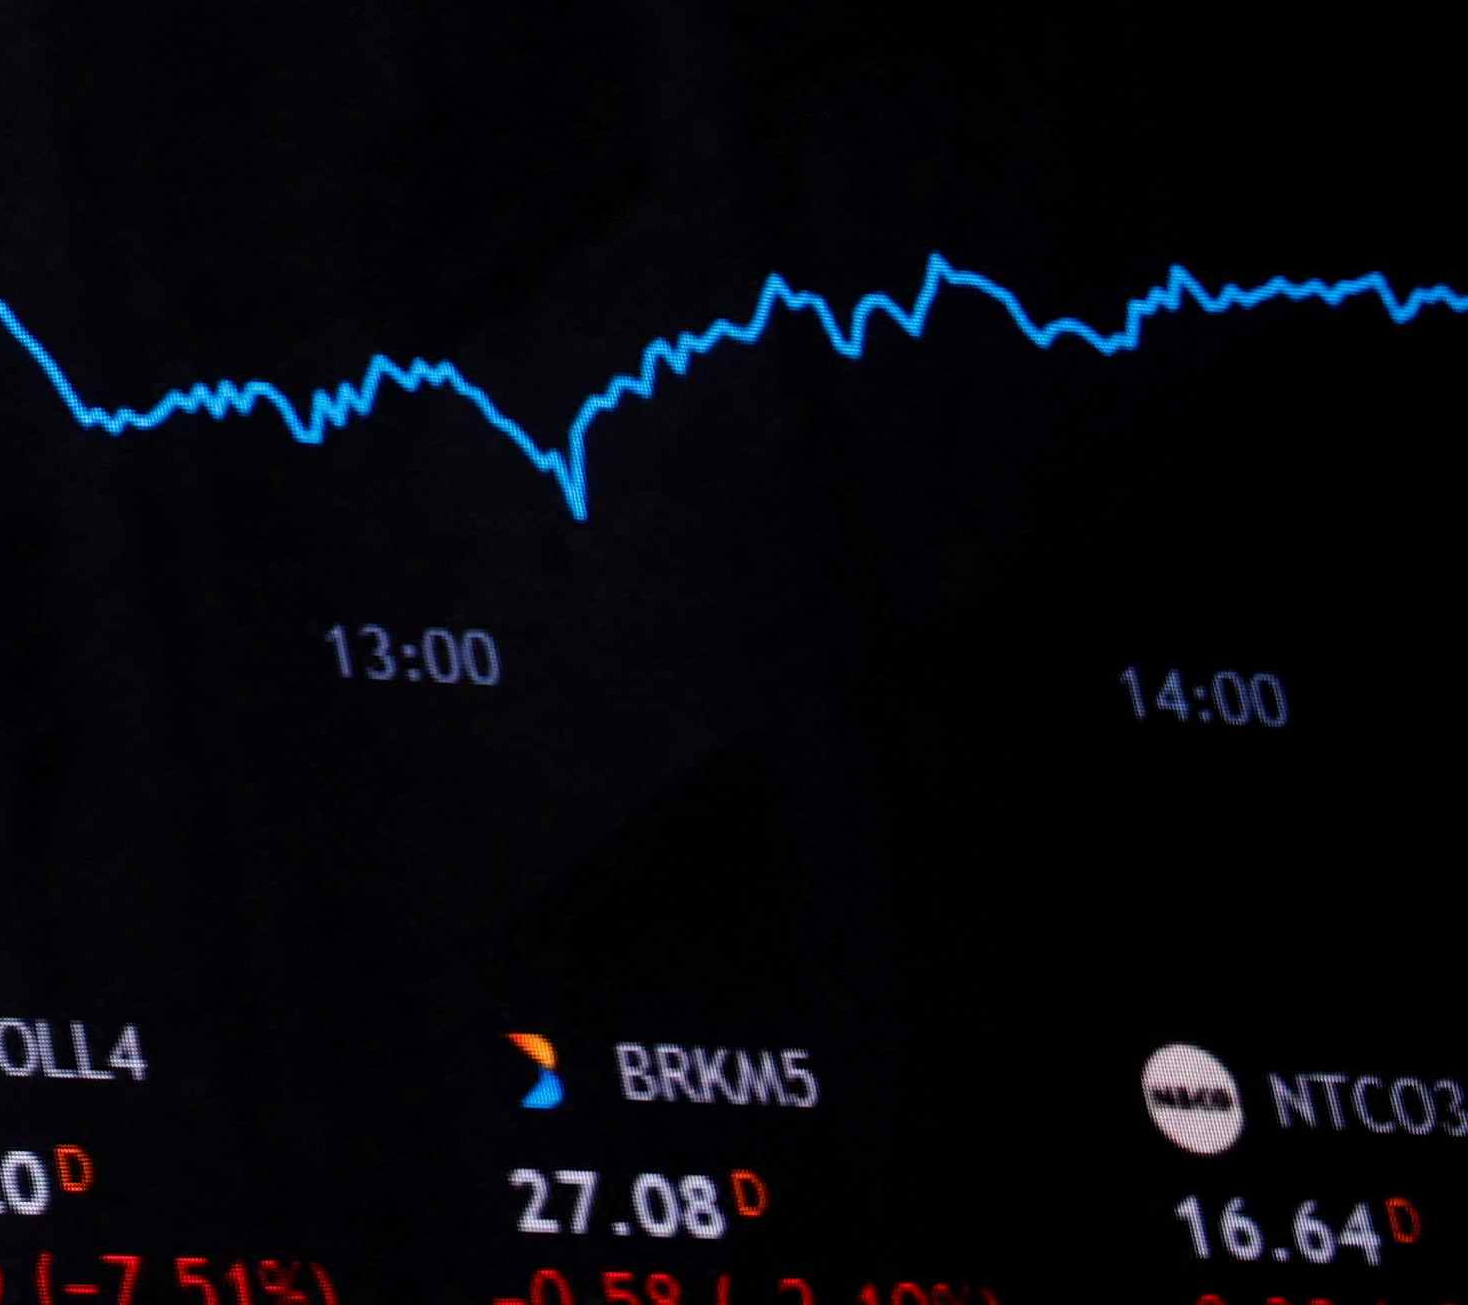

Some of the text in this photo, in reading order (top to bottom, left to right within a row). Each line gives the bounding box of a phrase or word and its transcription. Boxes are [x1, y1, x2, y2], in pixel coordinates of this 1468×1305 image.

[323, 620, 503, 689] 13:00
[1117, 662, 1288, 730] 14:00
[615, 1042, 821, 1109] BRKM5
[1265, 1070, 1468, 1138] NTCO3
[53, 1143, 95, 1193] D
[509, 1167, 767, 1241] 27.08 D
[1175, 1194, 1422, 1267] 16.64 D
[36, 1251, 339, 1305] (-751%)
